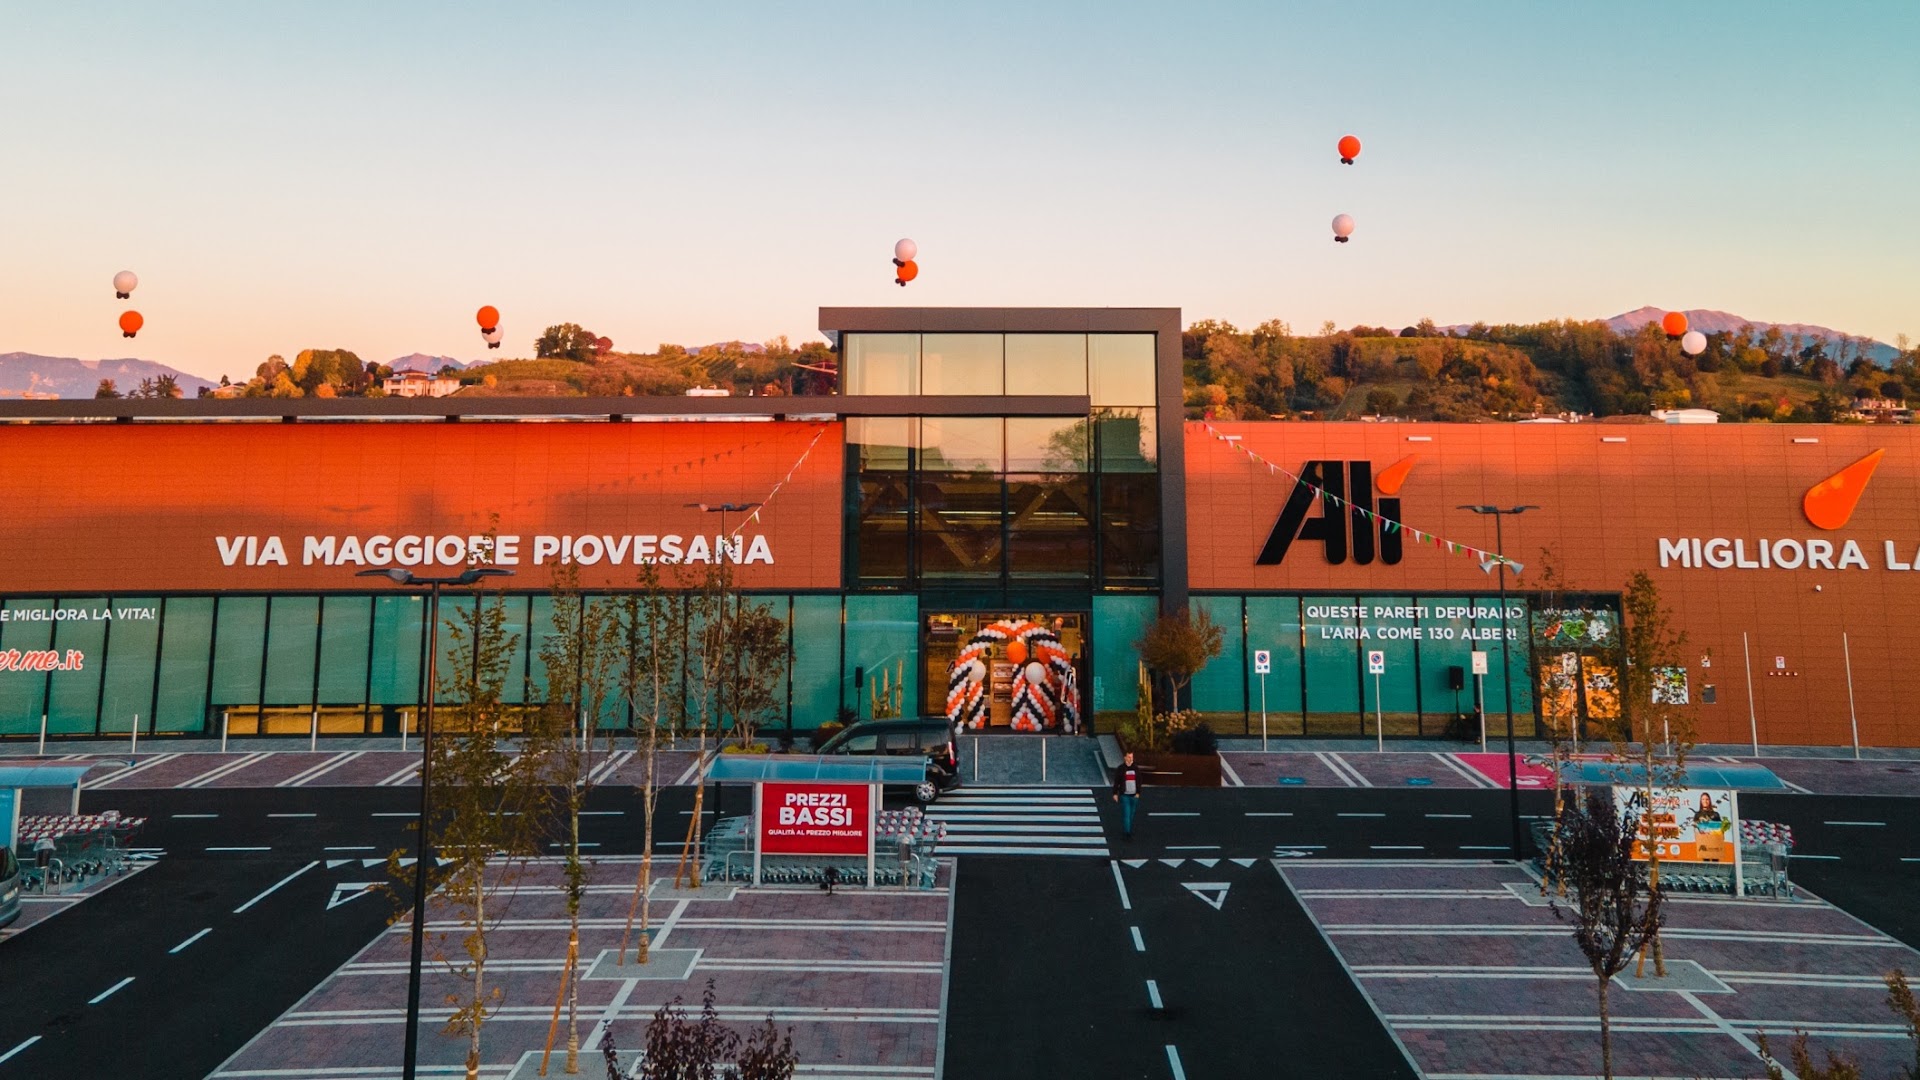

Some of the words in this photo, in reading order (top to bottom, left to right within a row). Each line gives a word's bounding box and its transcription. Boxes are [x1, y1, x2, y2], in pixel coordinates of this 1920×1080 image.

[216, 535, 288, 566] VIA
[303, 535, 520, 566] MAGGIORE
[533, 534, 775, 566] PIOVESANA
[1658, 537, 1869, 570] MIGLIORA
[1885, 539, 1920, 570] L
[13, 608, 88, 621] MIGLIORA
[92, 608, 112, 620] LA
[117, 607, 156, 620] VITA!
[1306, 606, 1368, 618] QUESTE
[1374, 606, 1429, 618] PARETI
[1435, 606, 1523, 619] DEPURANO
[1376, 627, 1422, 639] COME
[1428, 627, 1454, 640] 130
[785, 793, 847, 806] PREZZI
[779, 806, 852, 826] BASSI
[1642, 814, 1675, 822] SESA
[768, 828, 795, 836] QUALITÀ
